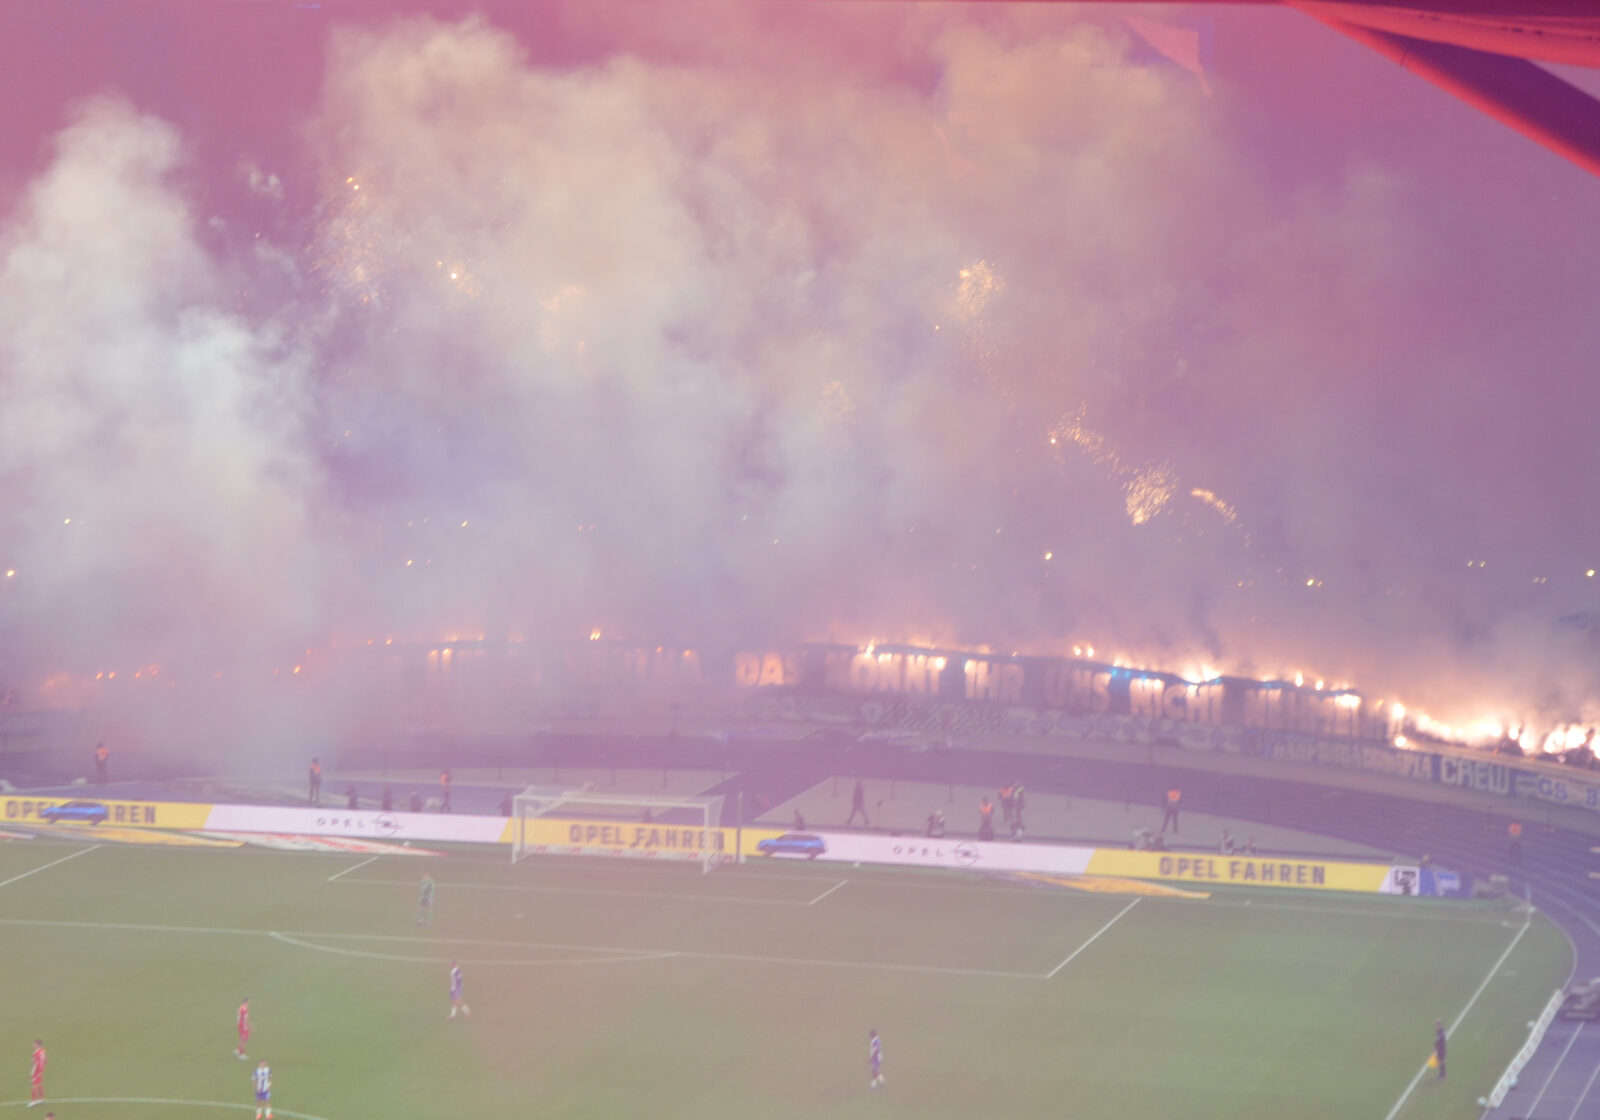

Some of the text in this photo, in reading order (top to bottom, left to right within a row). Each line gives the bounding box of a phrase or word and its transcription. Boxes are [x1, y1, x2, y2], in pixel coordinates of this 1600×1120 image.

[963, 659, 1026, 700] IHR
[1129, 677, 1225, 726] NICHT
[1440, 758, 1511, 795] CREW
[316, 816, 365, 829] OPEL
[568, 823, 725, 851] OPEL FAHREN
[1158, 856, 1326, 886] OPEL FAHREN
